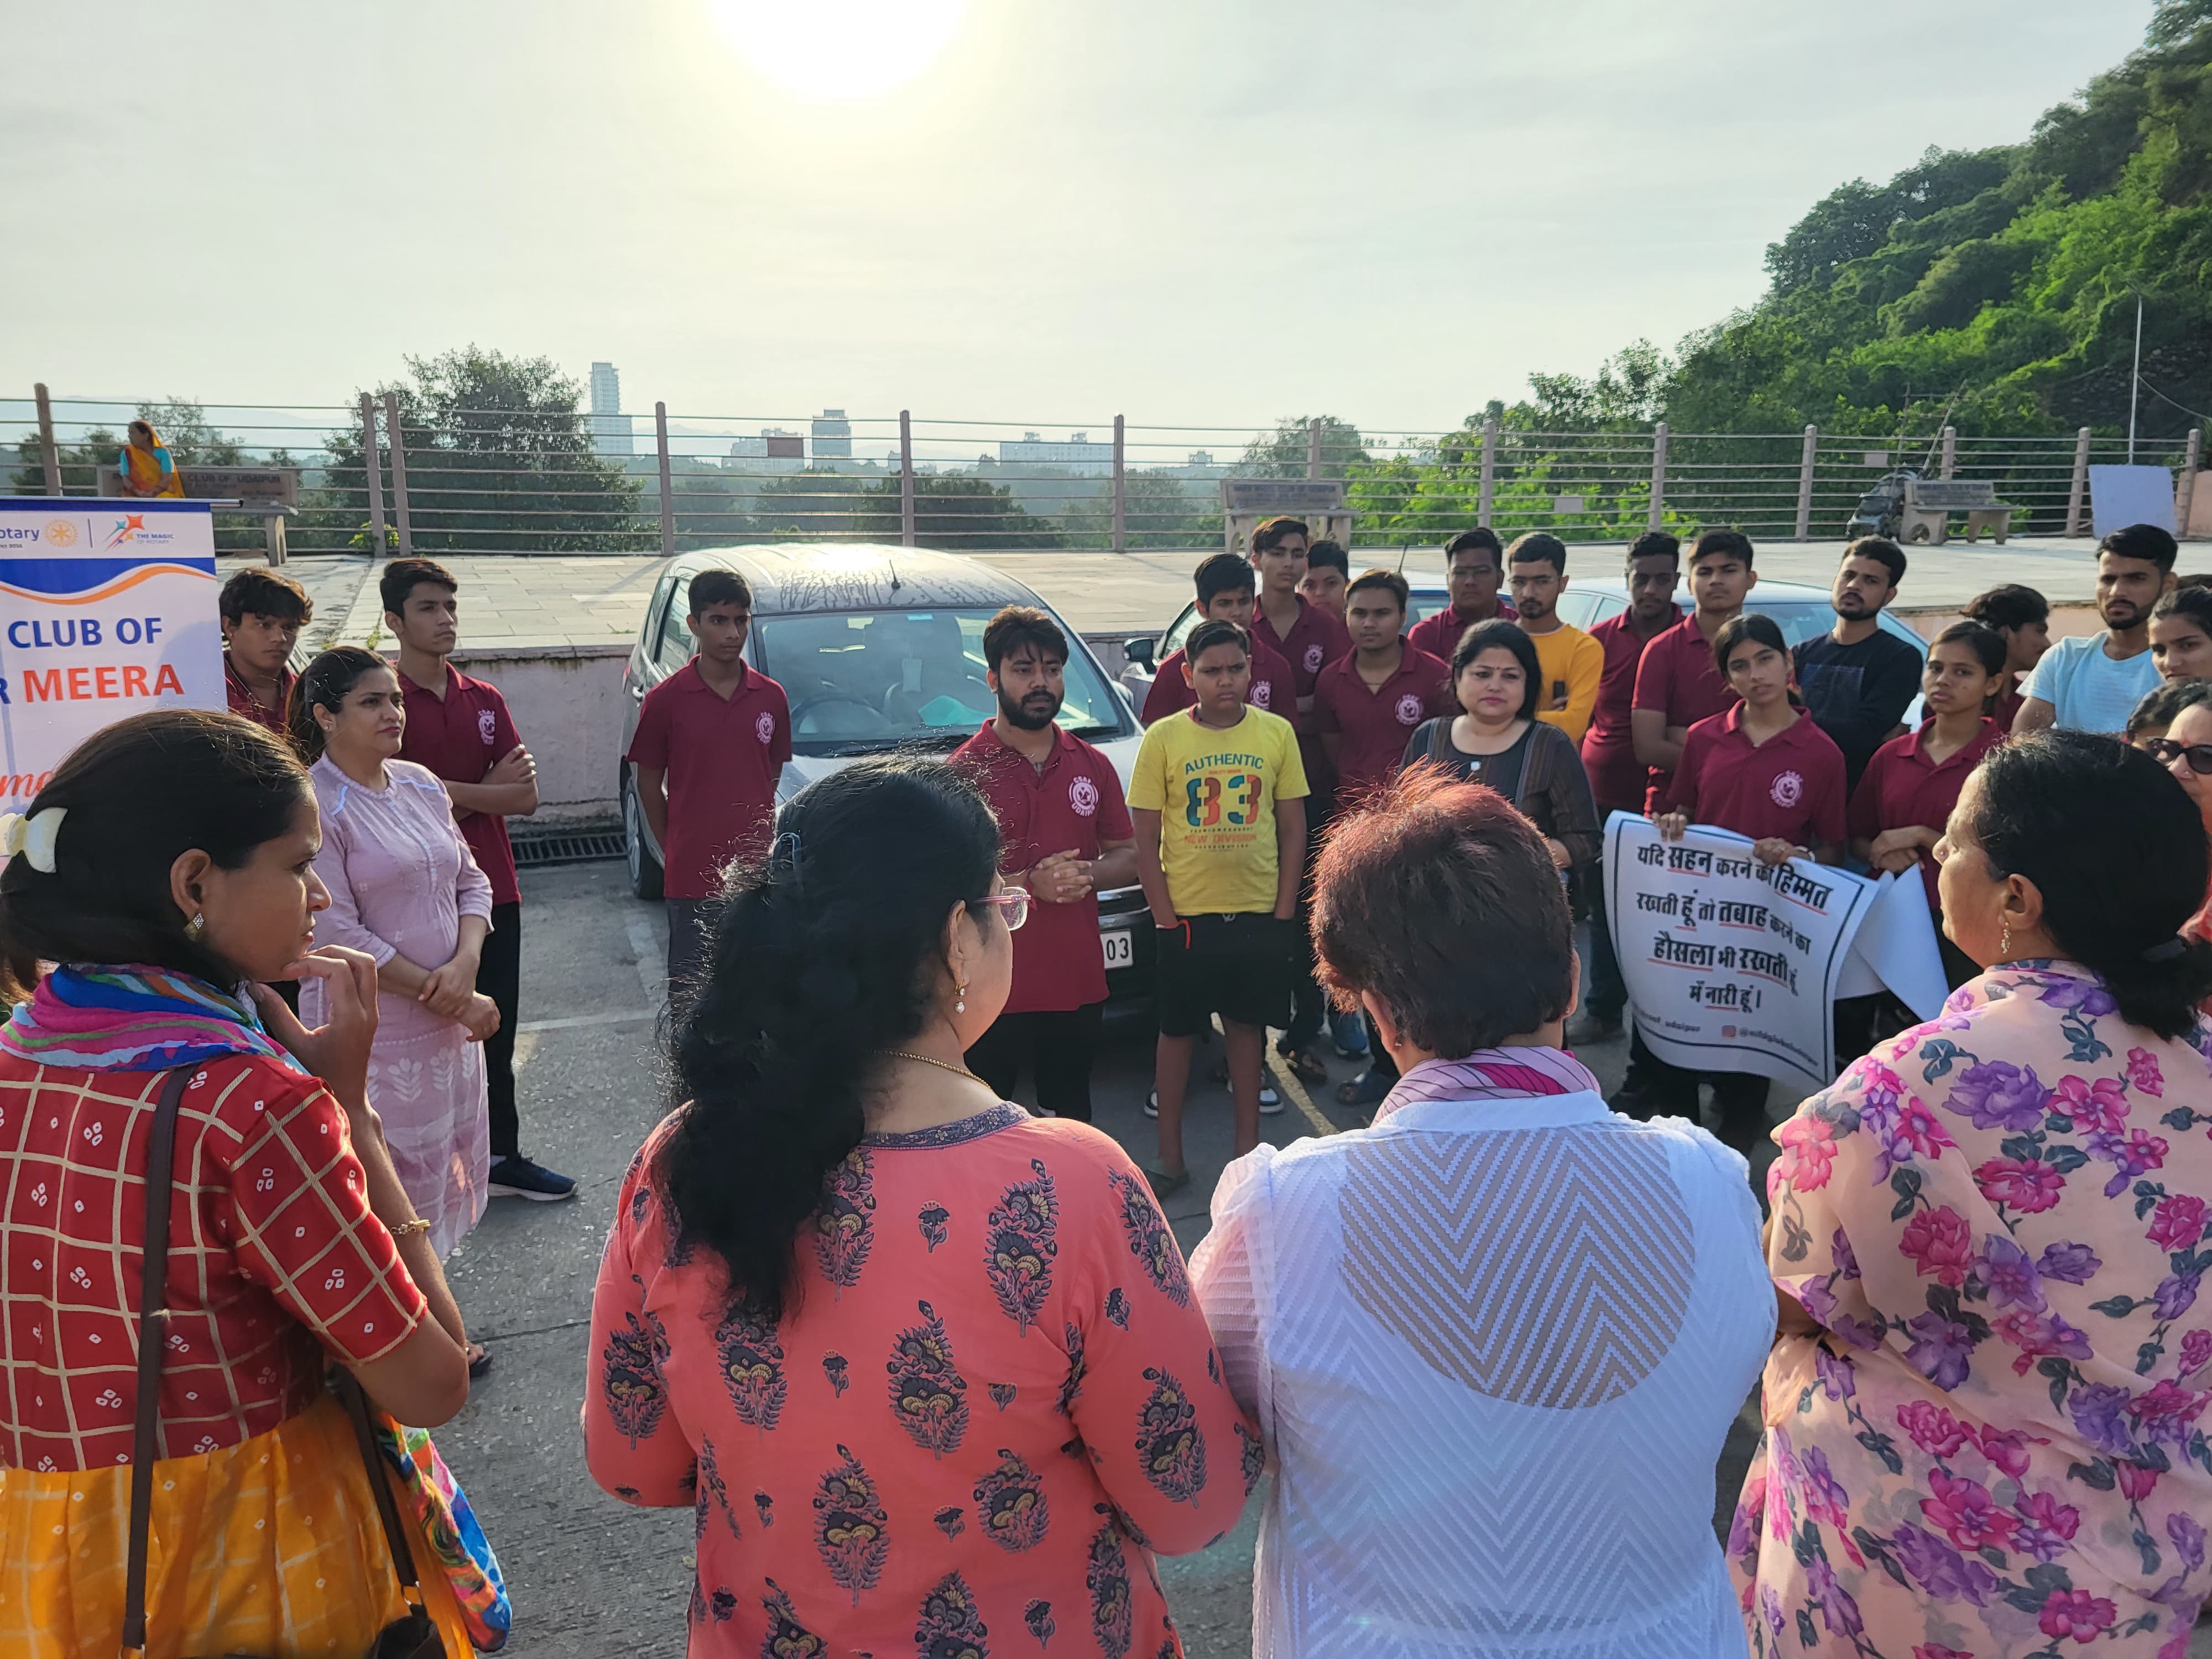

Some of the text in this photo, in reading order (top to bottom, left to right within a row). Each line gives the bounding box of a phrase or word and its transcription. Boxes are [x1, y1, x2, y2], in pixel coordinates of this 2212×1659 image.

[8, 618, 162, 648] CLUB OF
[23, 664, 185, 703] MEERA
[1185, 753, 1264, 775] AUTHENTIC
[1186, 775, 1262, 826] 83
[1637, 843, 1666, 866] यदि
[1668, 847, 1713, 874] सहन
[1715, 858, 1752, 879] करने
[1774, 863, 1834, 909] हिम्मत
[1636, 892, 1678, 916] रखती
[1698, 898, 1715, 921] तो
[1718, 901, 1769, 927] तबाह
[1106, 937, 1129, 961] 03
[1653, 930, 1716, 966] हौसला
[1718, 946, 1736, 968] भी
[1739, 948, 1788, 982] रखती
[1705, 983, 1738, 1005] नारी
